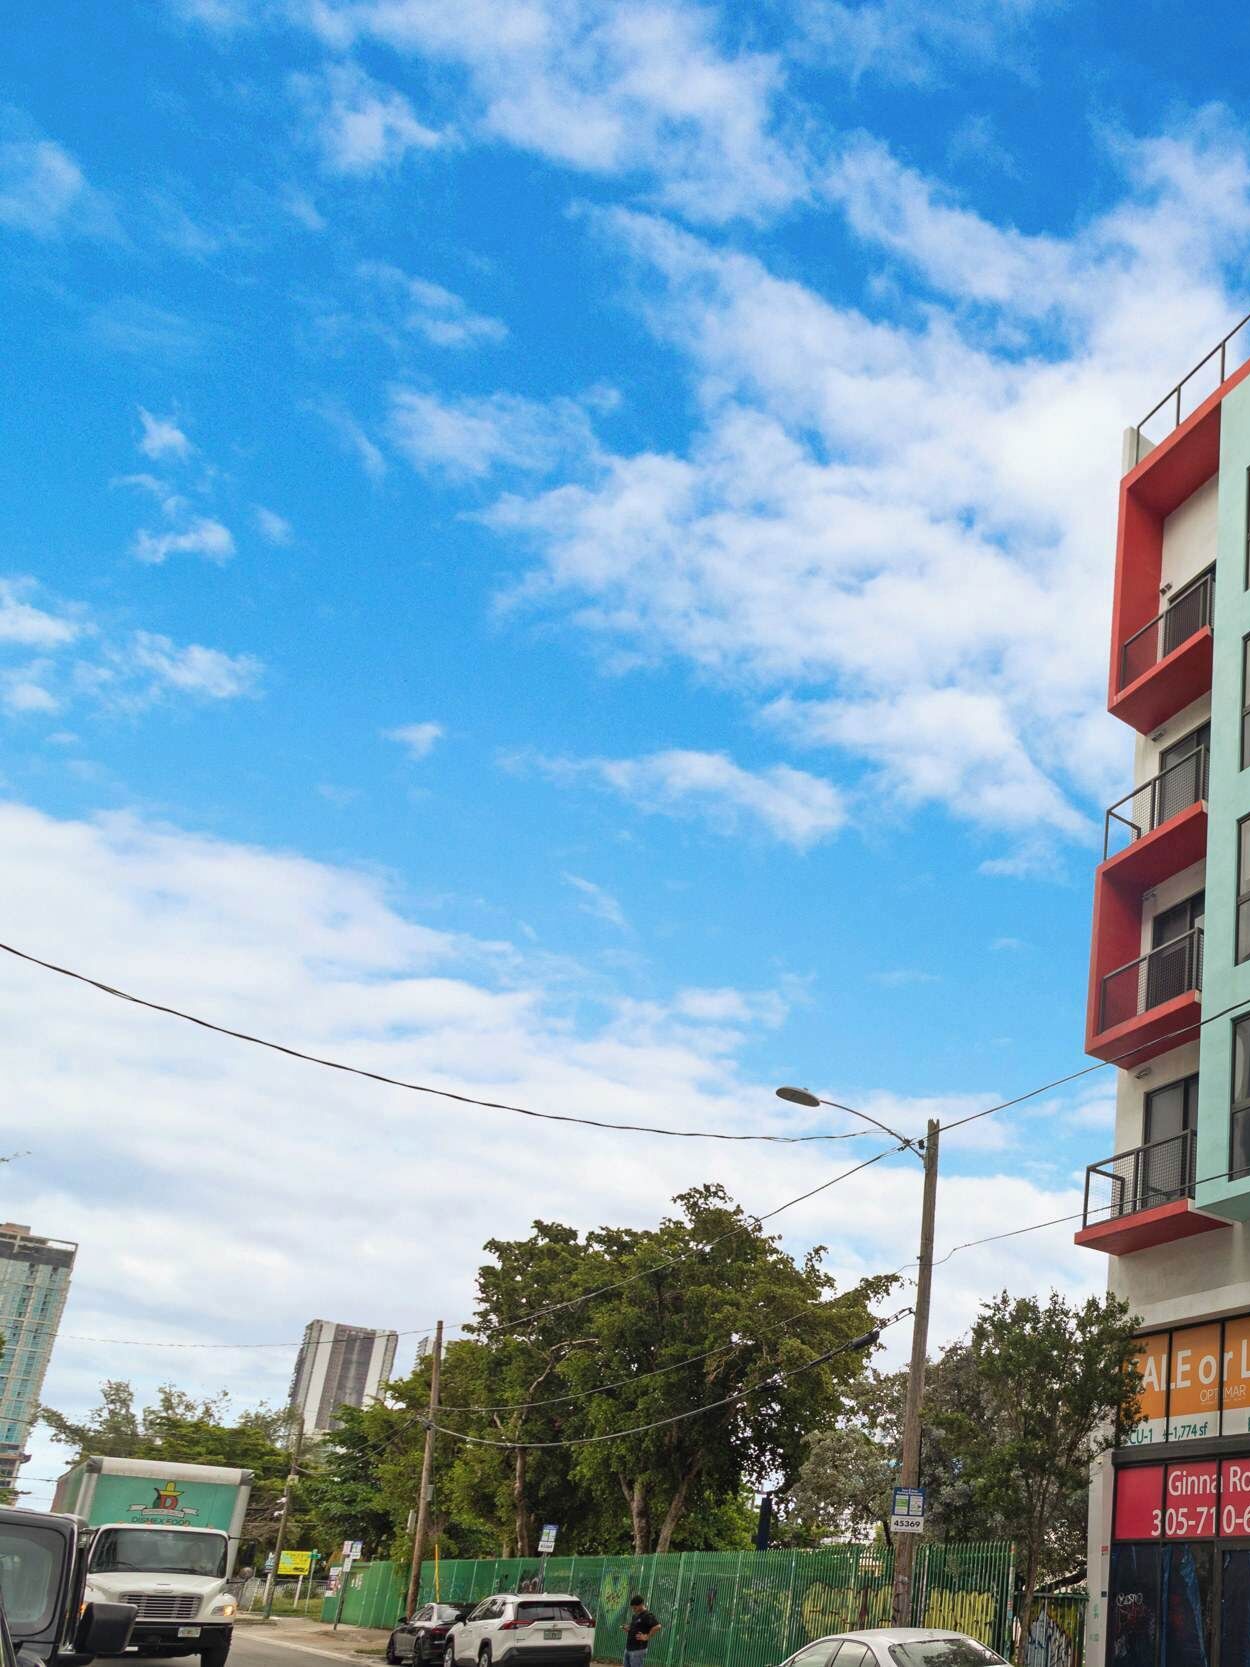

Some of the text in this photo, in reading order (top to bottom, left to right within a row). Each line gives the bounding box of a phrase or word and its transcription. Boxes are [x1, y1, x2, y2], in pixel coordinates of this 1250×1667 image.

[1130, 1349, 1192, 1392] ALE
[1198, 1350, 1233, 1385] or
[1200, 1385, 1247, 1402] OPTMAR
[1199, 1422, 1208, 1436] sf
[1168, 1470, 1223, 1496] Ginna
[894, 1520, 920, 1528] 45369
